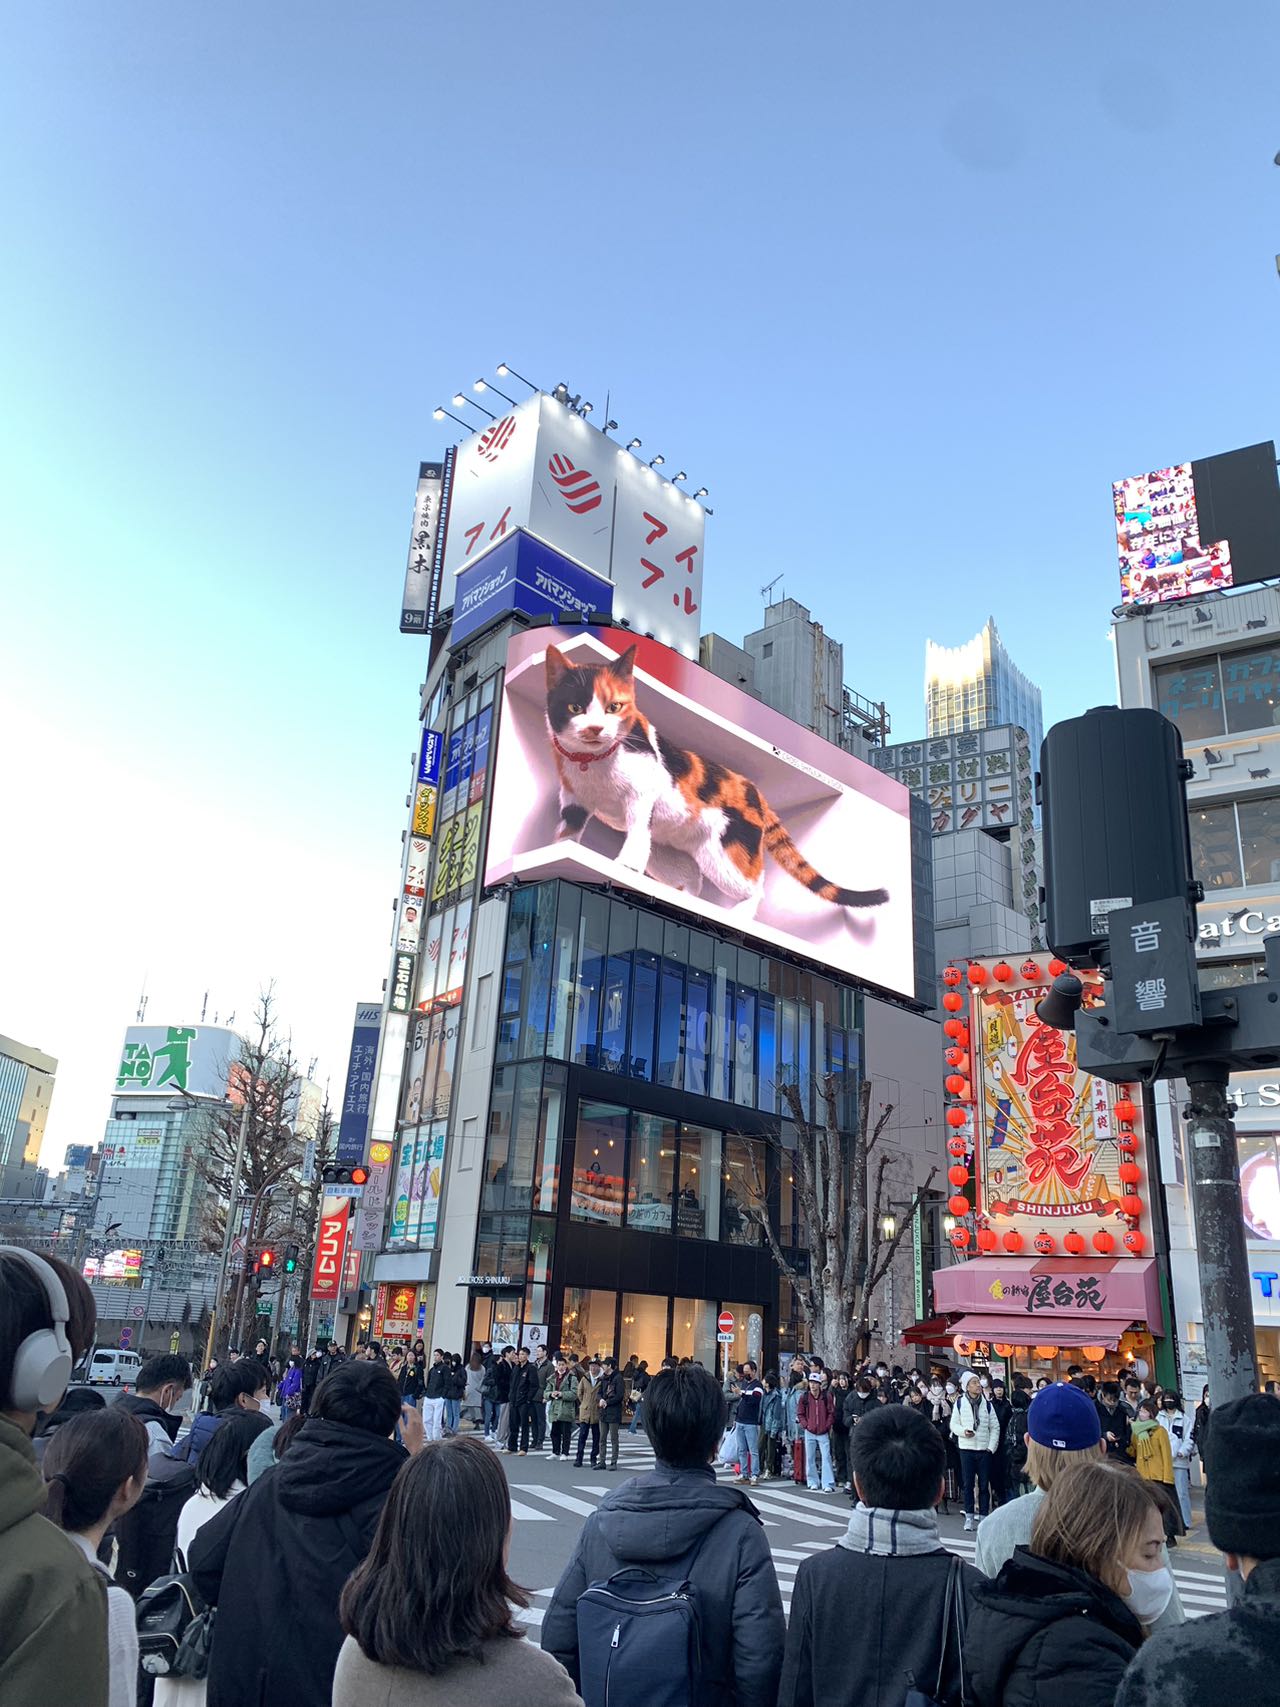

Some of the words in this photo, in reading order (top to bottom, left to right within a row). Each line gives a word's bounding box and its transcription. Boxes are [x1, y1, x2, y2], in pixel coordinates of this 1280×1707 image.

[409, 531, 431, 574] 黒木
[917, 783, 1009, 809] ジェリー
[1130, 920, 1168, 1012] 音響
[393, 956, 411, 1010] 宝石広場
[1008, 987, 1049, 1001] YATA
[359, 1010, 380, 1020] HIS
[125, 1043, 151, 1060] TA
[120, 1060, 151, 1077] NO
[1016, 1202, 1093, 1216] SHINJUKU
[319, 1221, 342, 1274] アコム
[1025, 1275, 1107, 1312] 屋台苑
